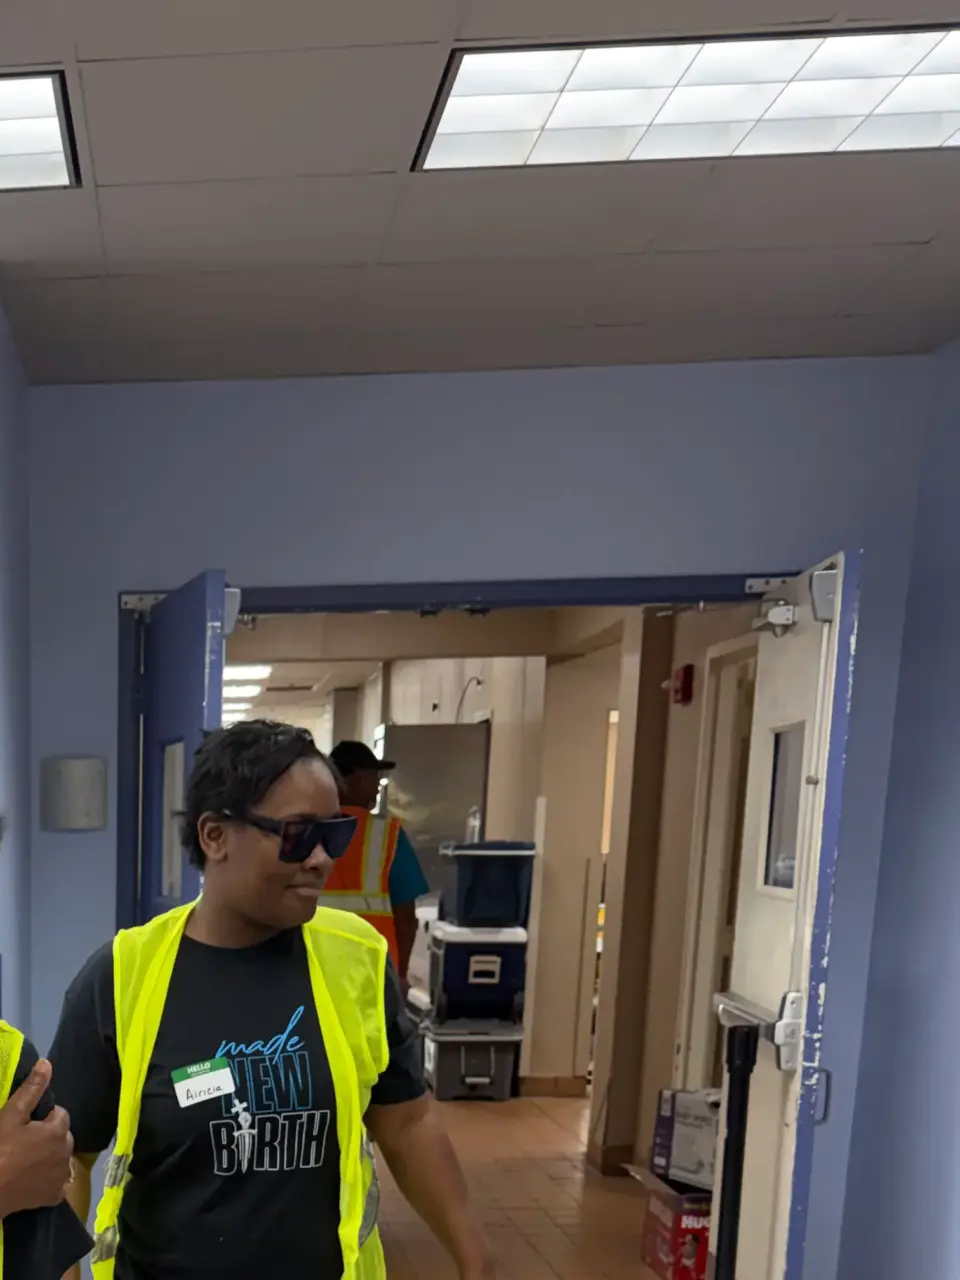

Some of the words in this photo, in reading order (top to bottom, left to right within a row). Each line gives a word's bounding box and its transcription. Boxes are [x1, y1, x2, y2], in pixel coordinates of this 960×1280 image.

[215, 1005, 305, 1064] made
[186, 1062, 211, 1074] HELLO
[222, 1051, 313, 1117] NEW
